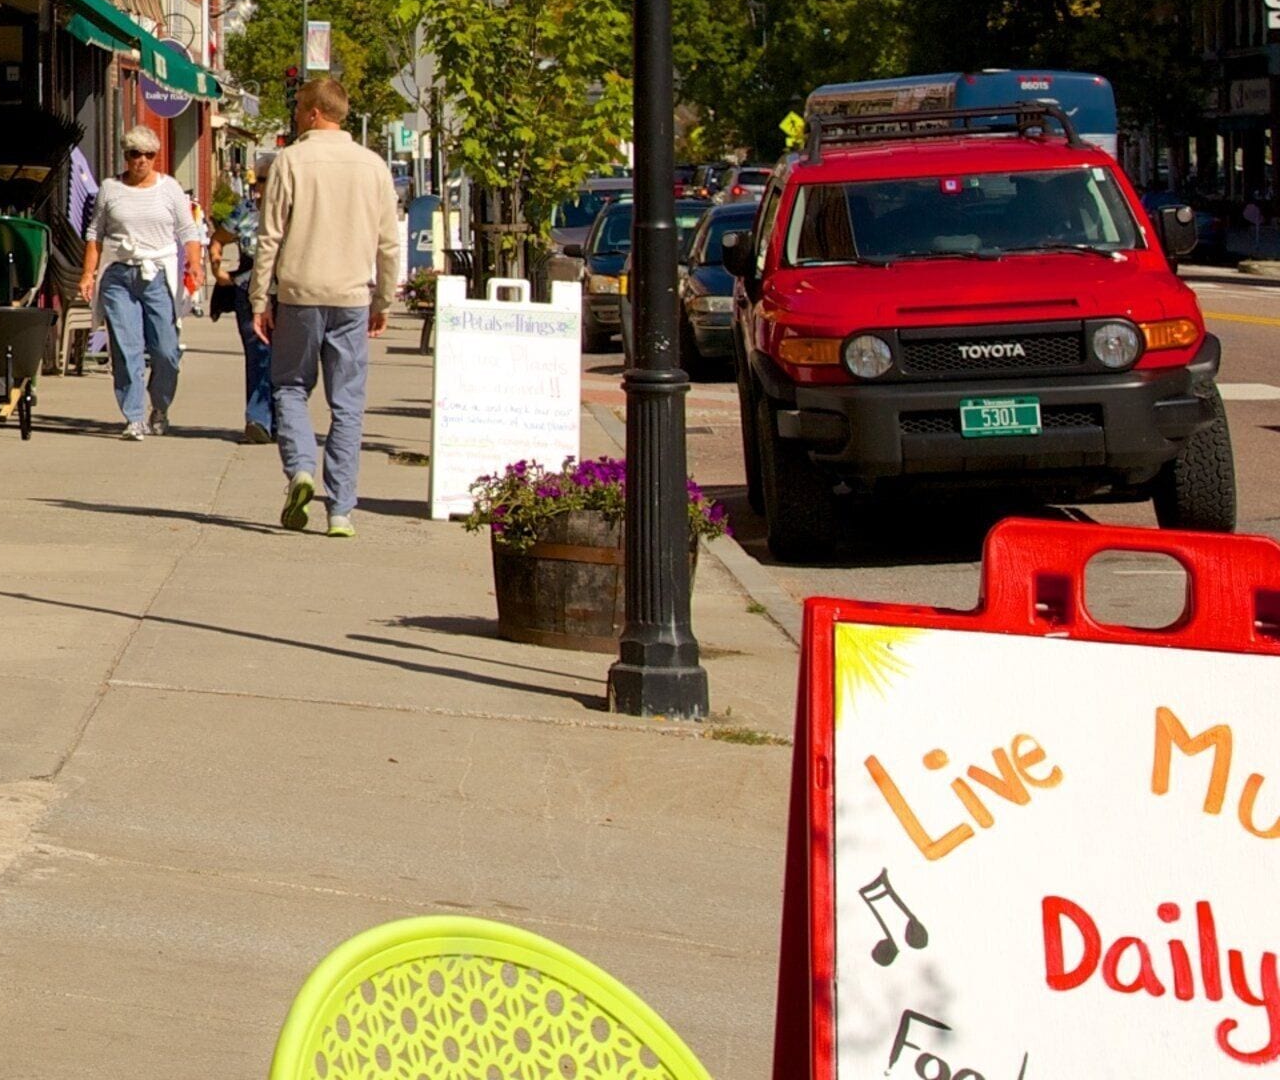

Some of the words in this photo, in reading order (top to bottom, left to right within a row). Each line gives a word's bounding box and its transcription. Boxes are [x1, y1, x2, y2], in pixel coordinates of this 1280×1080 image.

[958, 343, 1026, 359] TOYOTA
[982, 408, 1019, 427] 5301
[864, 733, 1064, 861] Live
[1042, 895, 1280, 1066] Daily
[885, 1008, 1029, 1080] Fo
